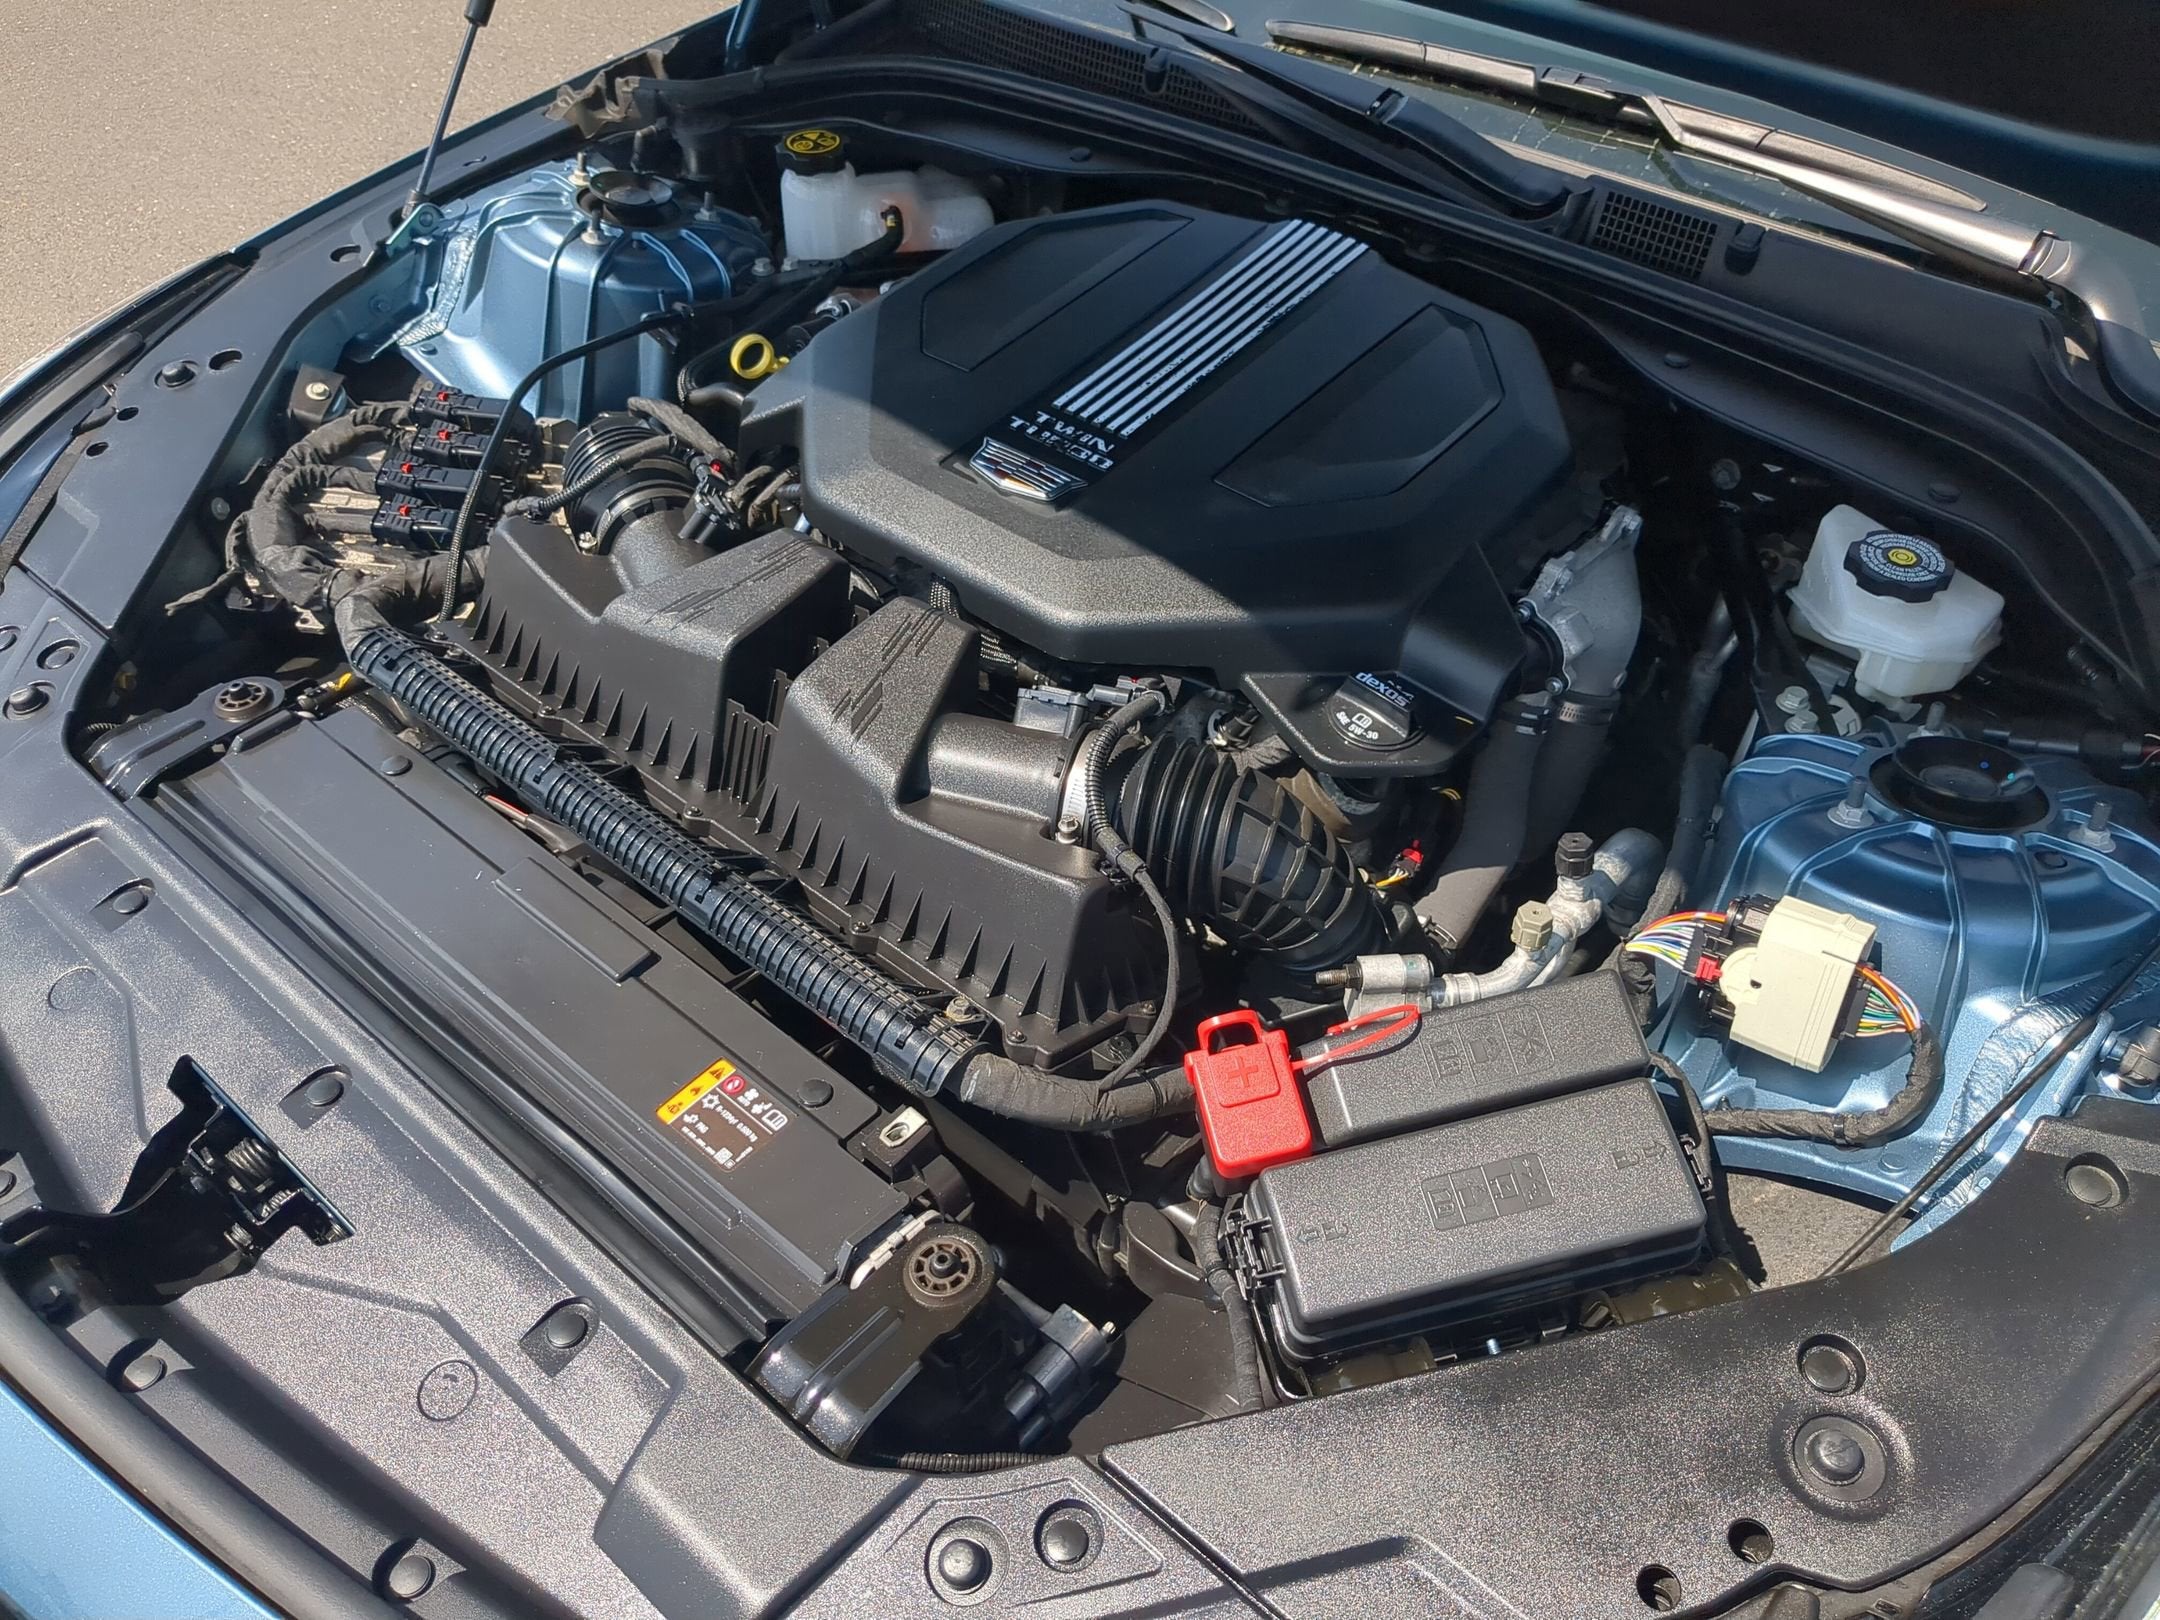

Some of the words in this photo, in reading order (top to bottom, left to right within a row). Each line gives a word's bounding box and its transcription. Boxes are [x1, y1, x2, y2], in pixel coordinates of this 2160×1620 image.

[1036, 410, 1115, 453] TWIN
[1355, 672, 1410, 707] dexos
[1336, 711, 1350, 726] SAE
[1348, 723, 1379, 740] 5W-30
